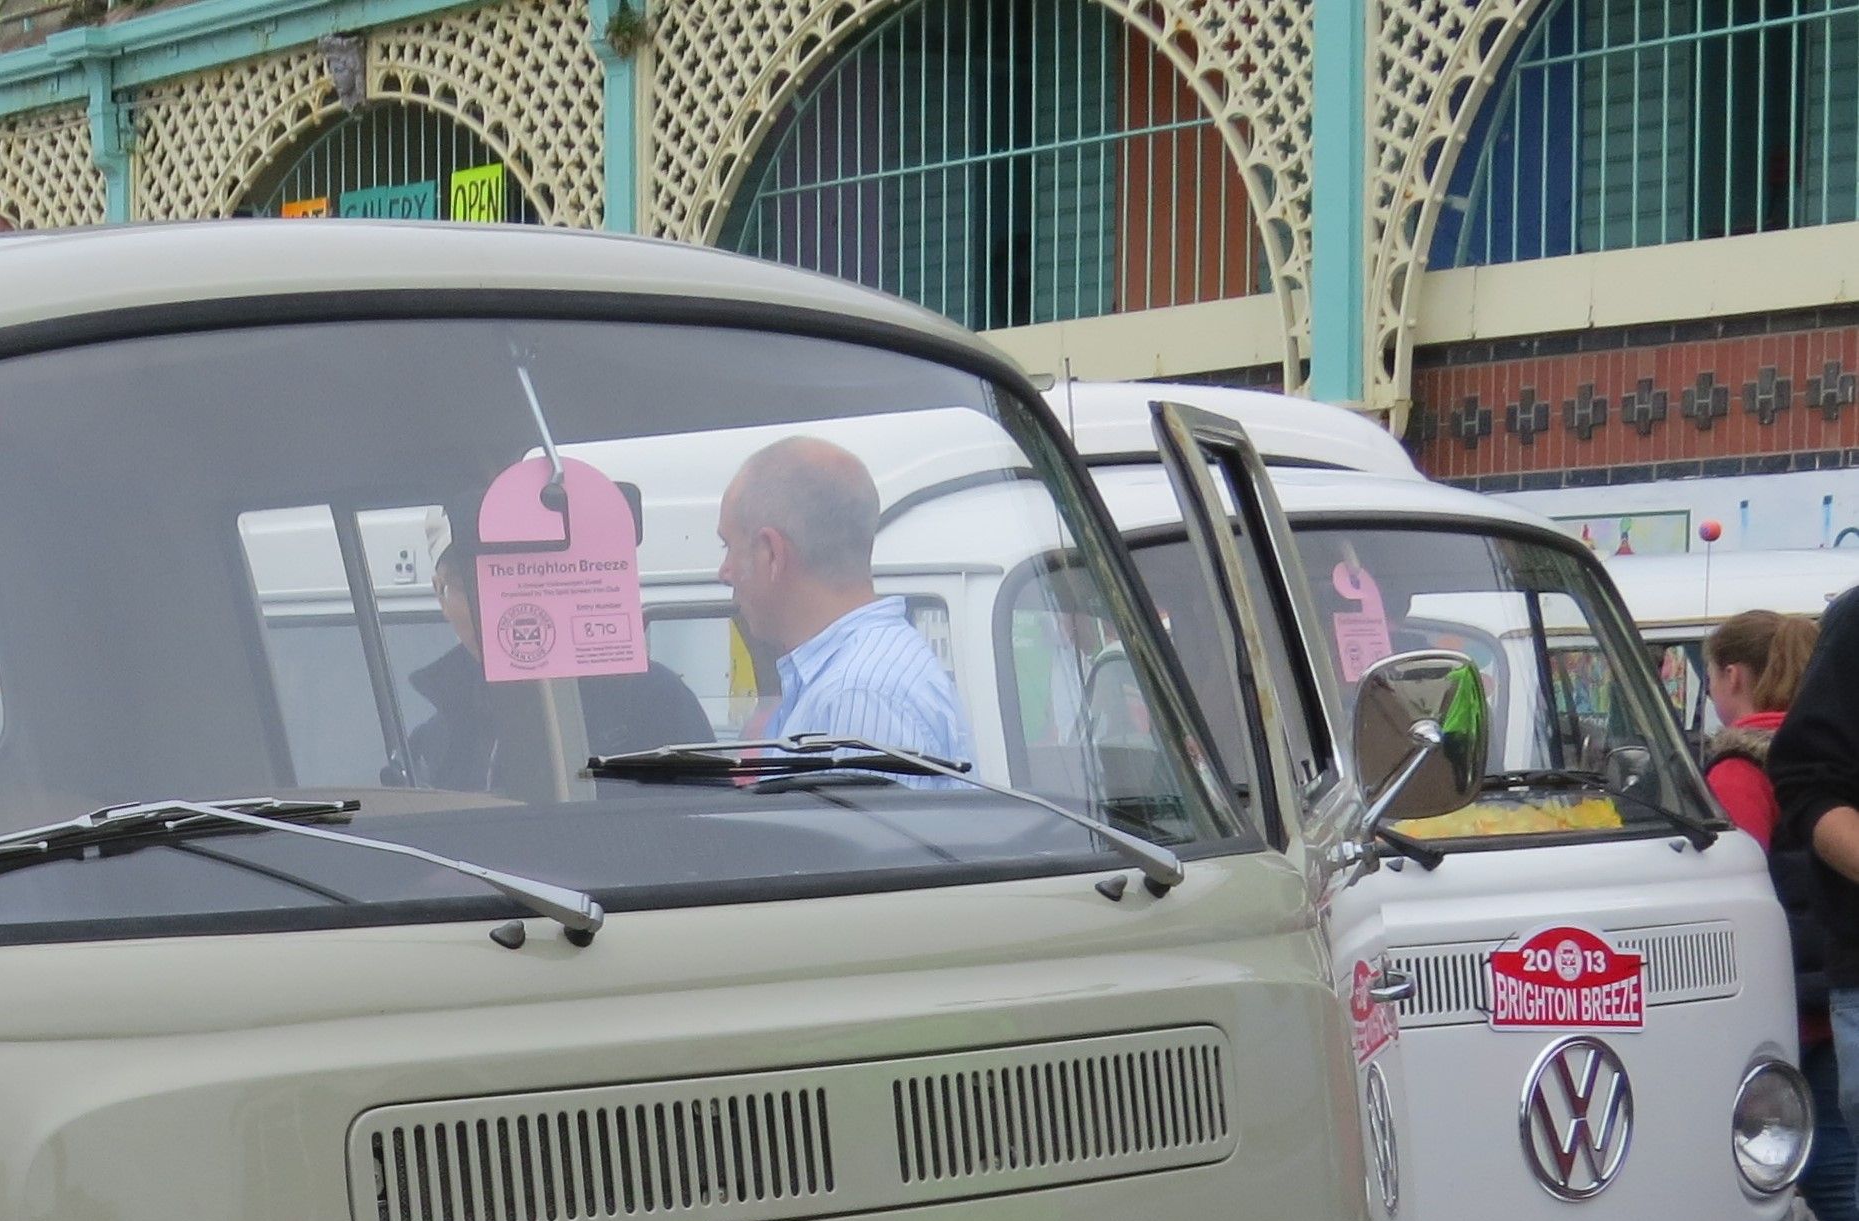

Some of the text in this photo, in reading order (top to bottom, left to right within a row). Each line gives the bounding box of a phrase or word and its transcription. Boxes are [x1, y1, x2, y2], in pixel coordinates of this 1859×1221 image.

[453, 176, 500, 222] OPEN
[489, 559, 629, 577] The Brighton Breeze
[584, 622, 617, 637] 870
[1495, 971, 1640, 1022] BRIGHTON BREEZE
